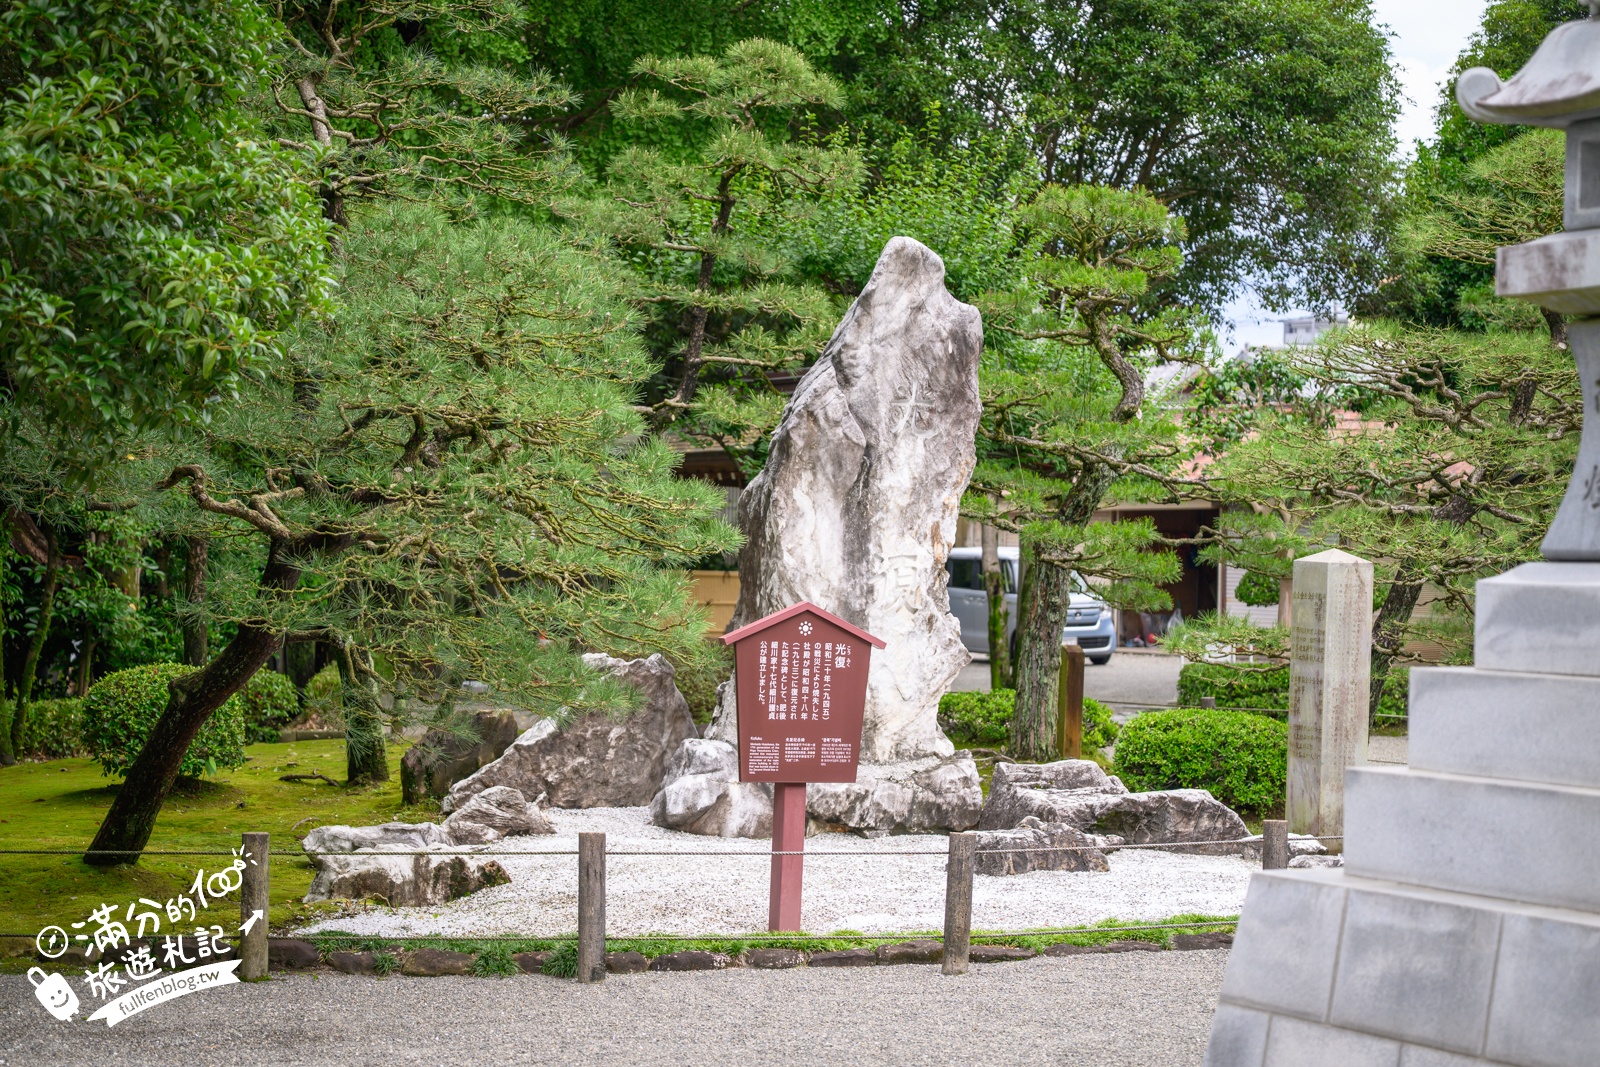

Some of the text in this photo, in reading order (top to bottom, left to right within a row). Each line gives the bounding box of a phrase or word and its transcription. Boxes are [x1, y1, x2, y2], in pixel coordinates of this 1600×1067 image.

[801, 642, 810, 720] 社殿が昭和四十八年
[835, 643, 846, 668] 光復
